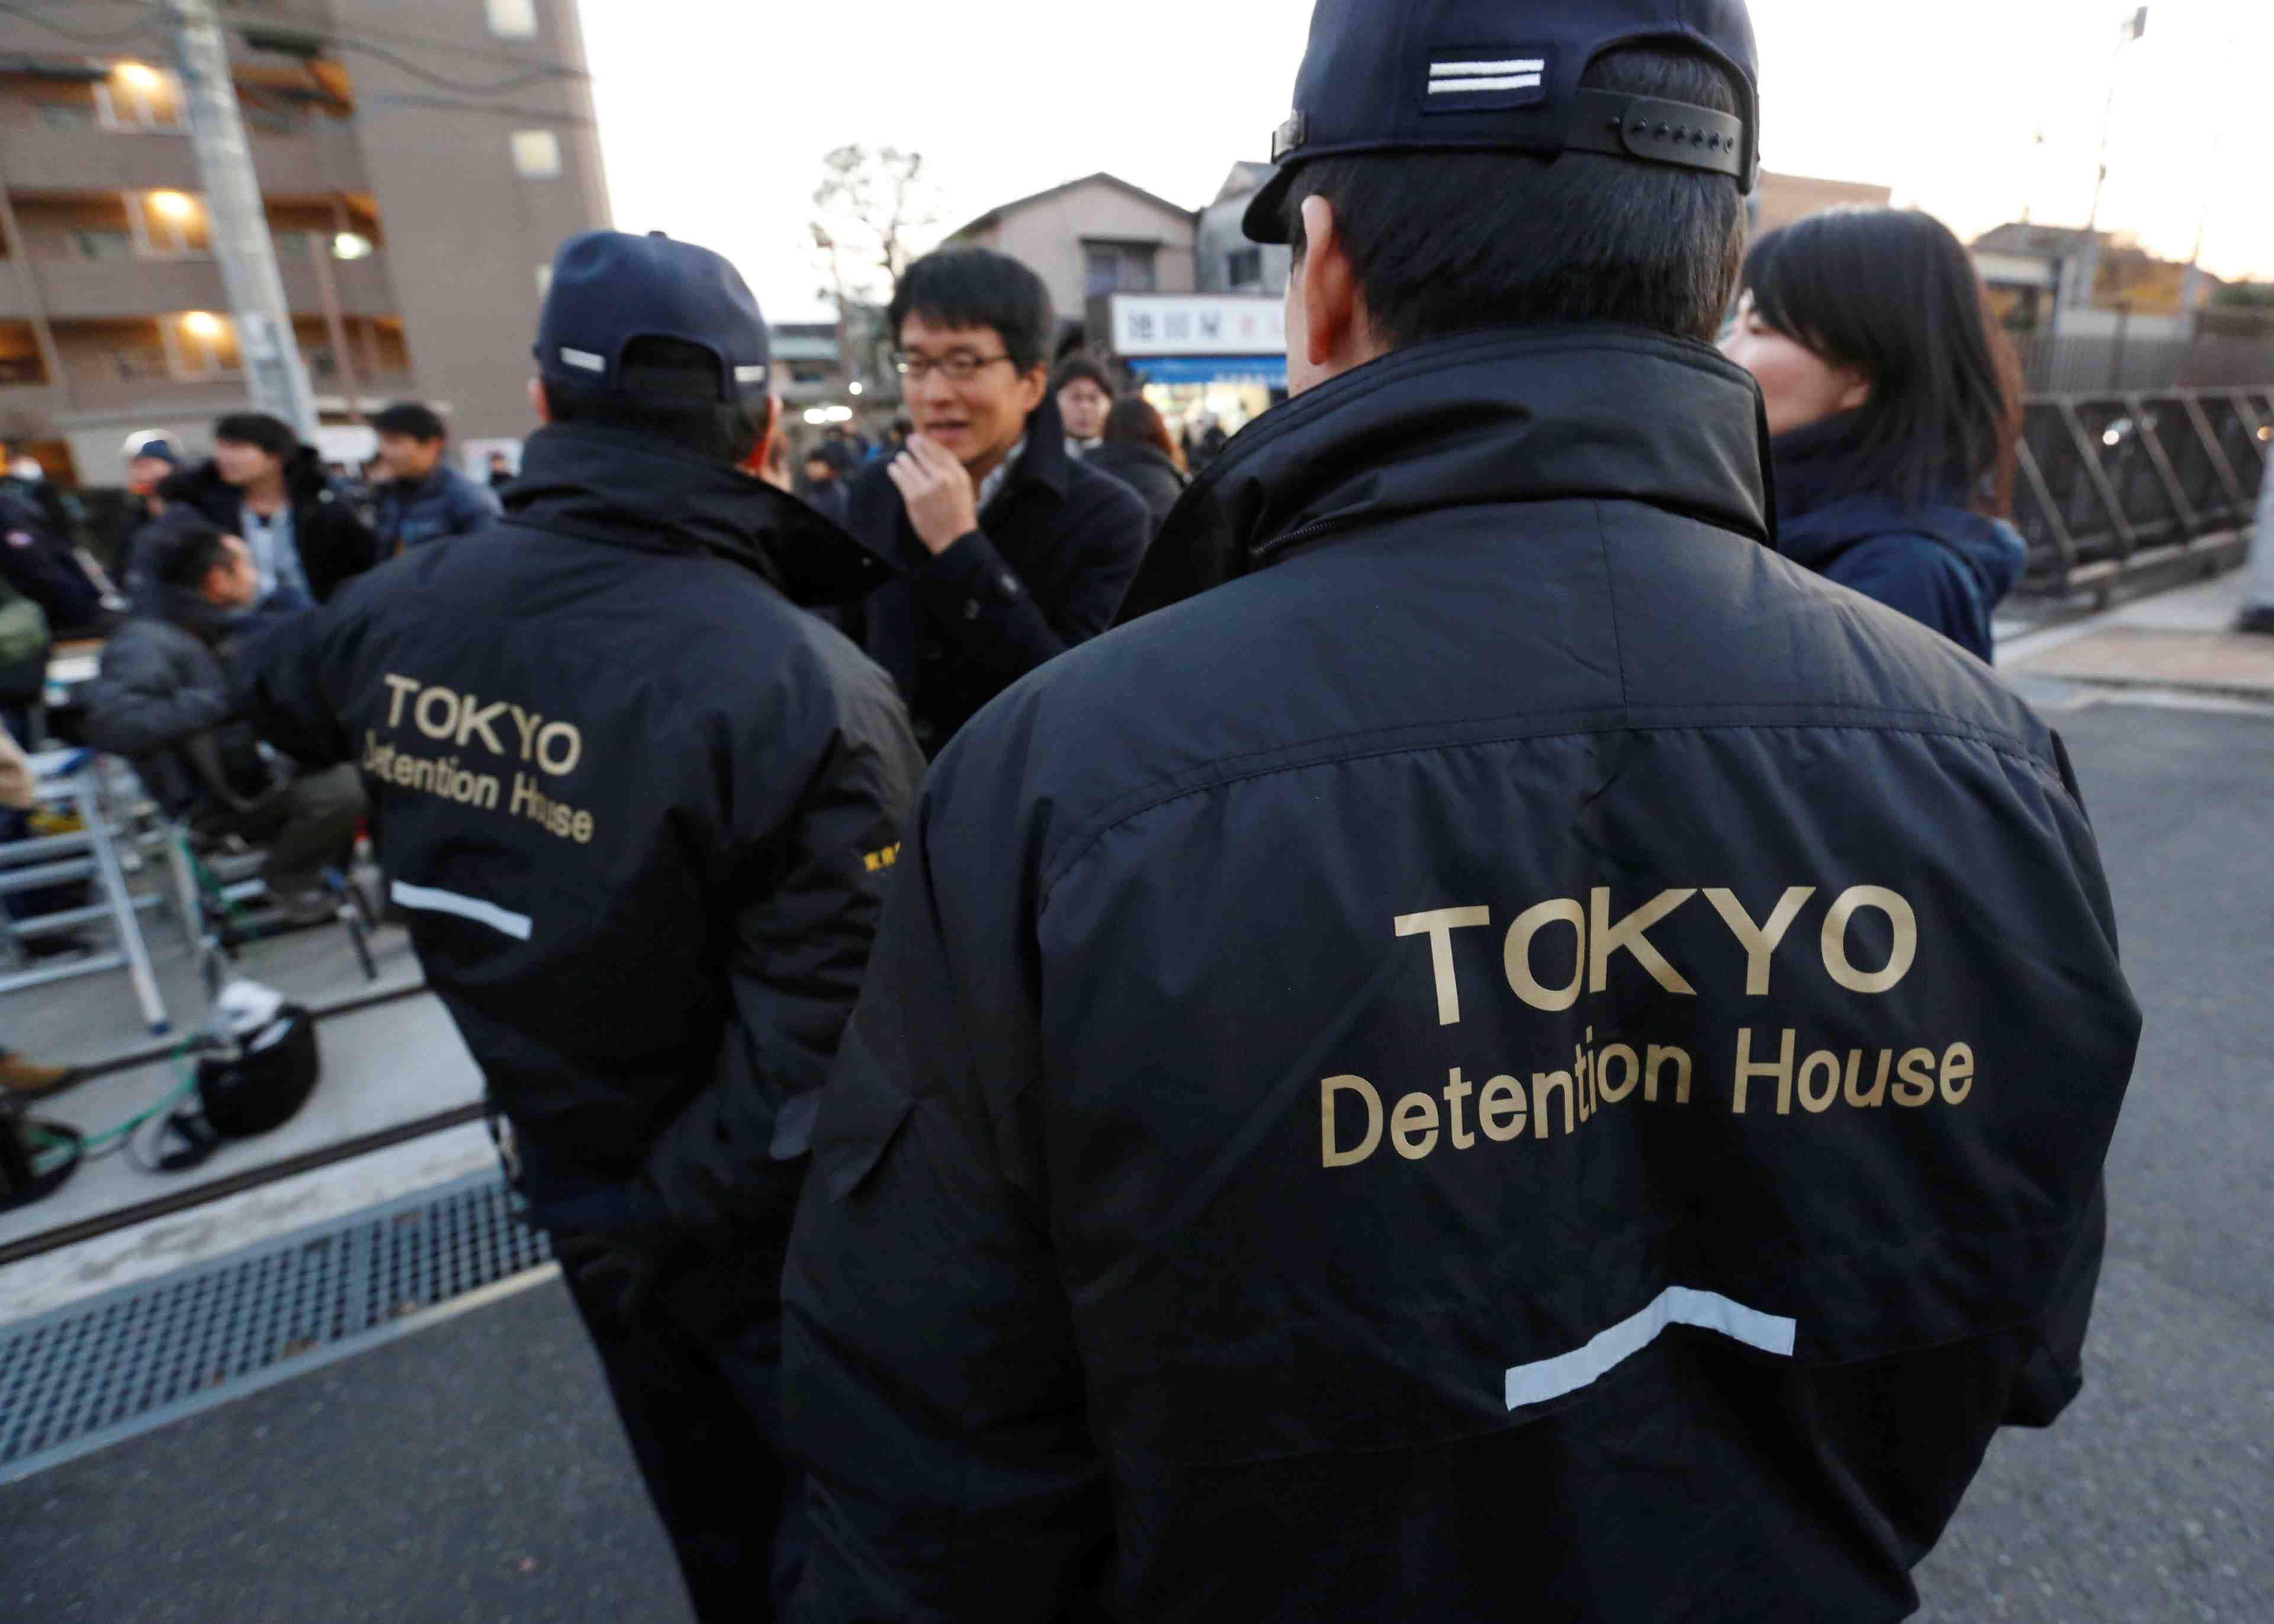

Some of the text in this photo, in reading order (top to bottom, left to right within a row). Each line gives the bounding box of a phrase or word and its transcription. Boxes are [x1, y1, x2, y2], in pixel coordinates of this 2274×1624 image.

[364, 729, 594, 844] tention Huse
[384, 673, 582, 775] TOKYO
[1393, 885, 1918, 1025] TOKYO
[1321, 1026, 1974, 1168] Detention House
